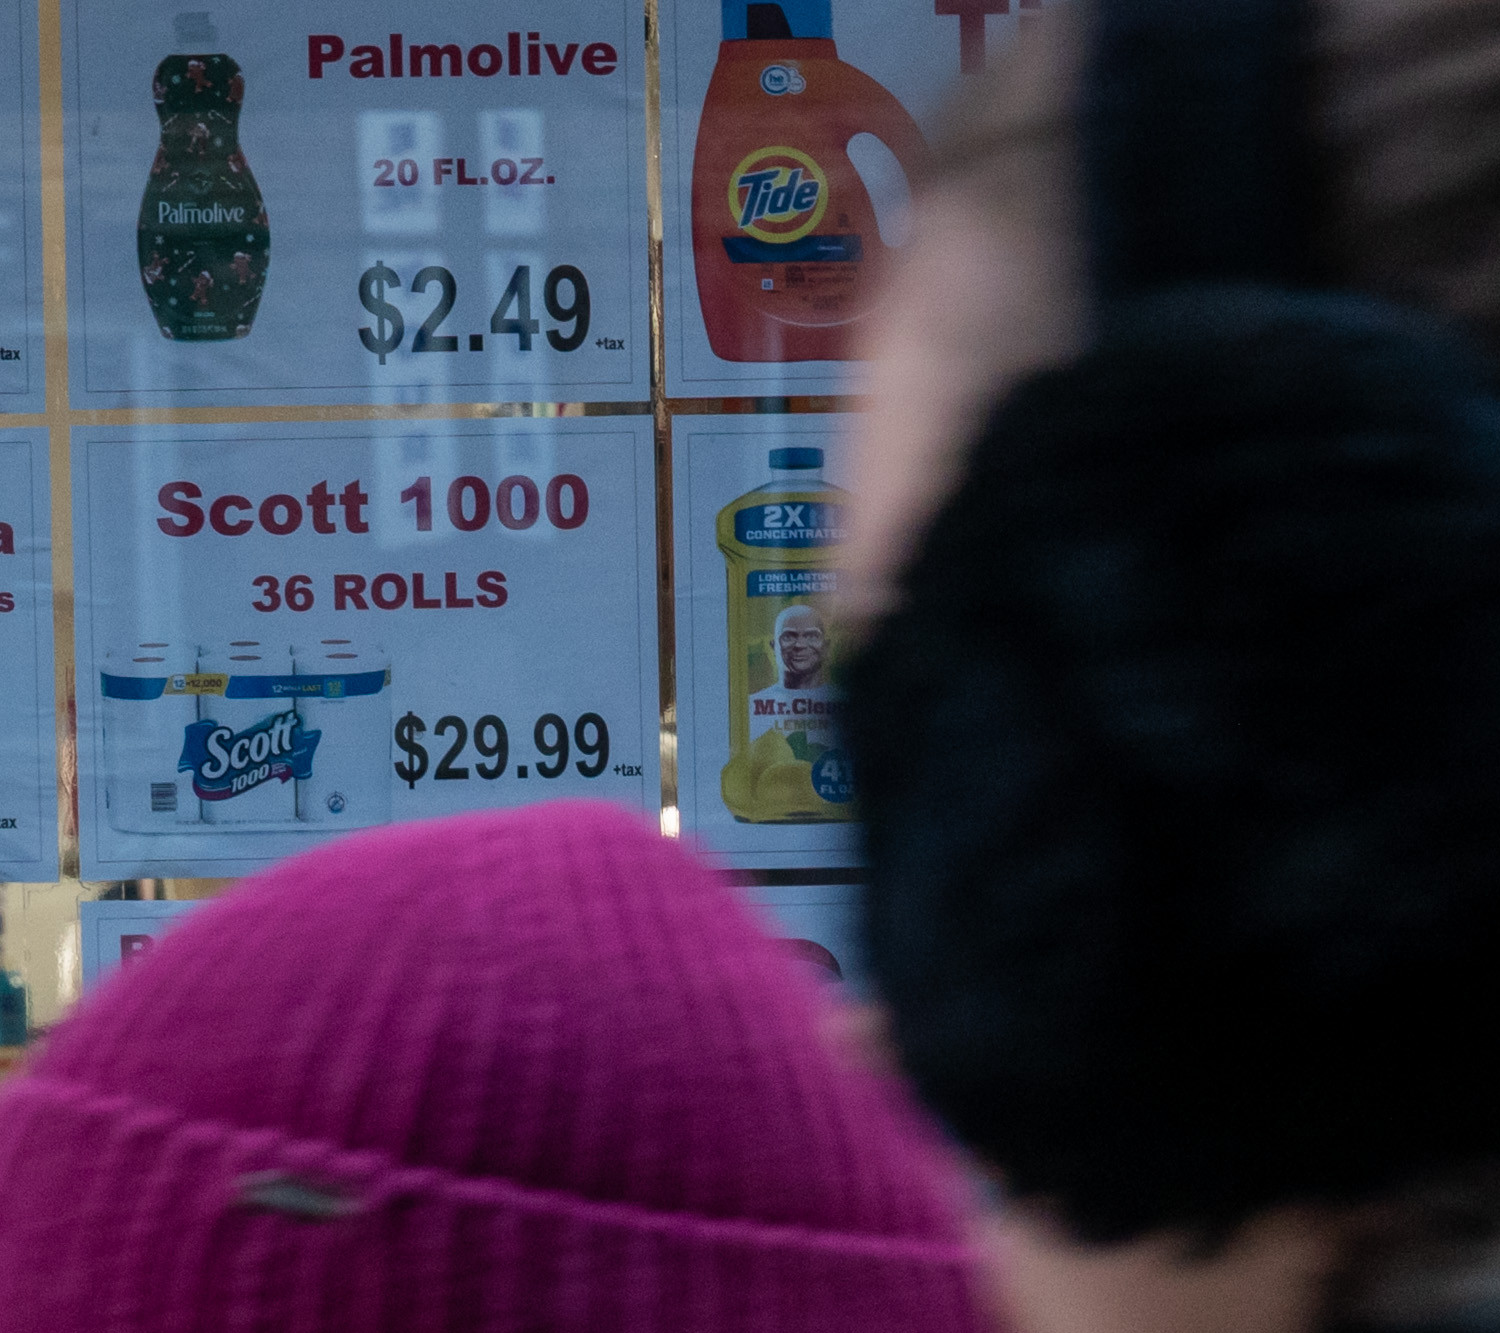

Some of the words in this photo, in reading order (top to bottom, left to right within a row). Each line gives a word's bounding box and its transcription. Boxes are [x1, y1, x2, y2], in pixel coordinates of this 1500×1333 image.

[307, 31, 618, 79] Palmolive
[373, 159, 418, 187] 20
[433, 158, 556, 186] FL.OZ.
[158, 202, 245, 225] Palmolive
[738, 169, 820, 228] Tide
[358, 261, 591, 365] $2.49
[594, 337, 625, 351] +tax
[156, 479, 369, 537] Scott
[399, 474, 589, 532] 1000
[763, 506, 804, 528] 2X
[252, 575, 315, 612] 36
[333, 572, 508, 610] ROLLS
[394, 711, 610, 789] $29.99
[613, 763, 642, 777] +tax
